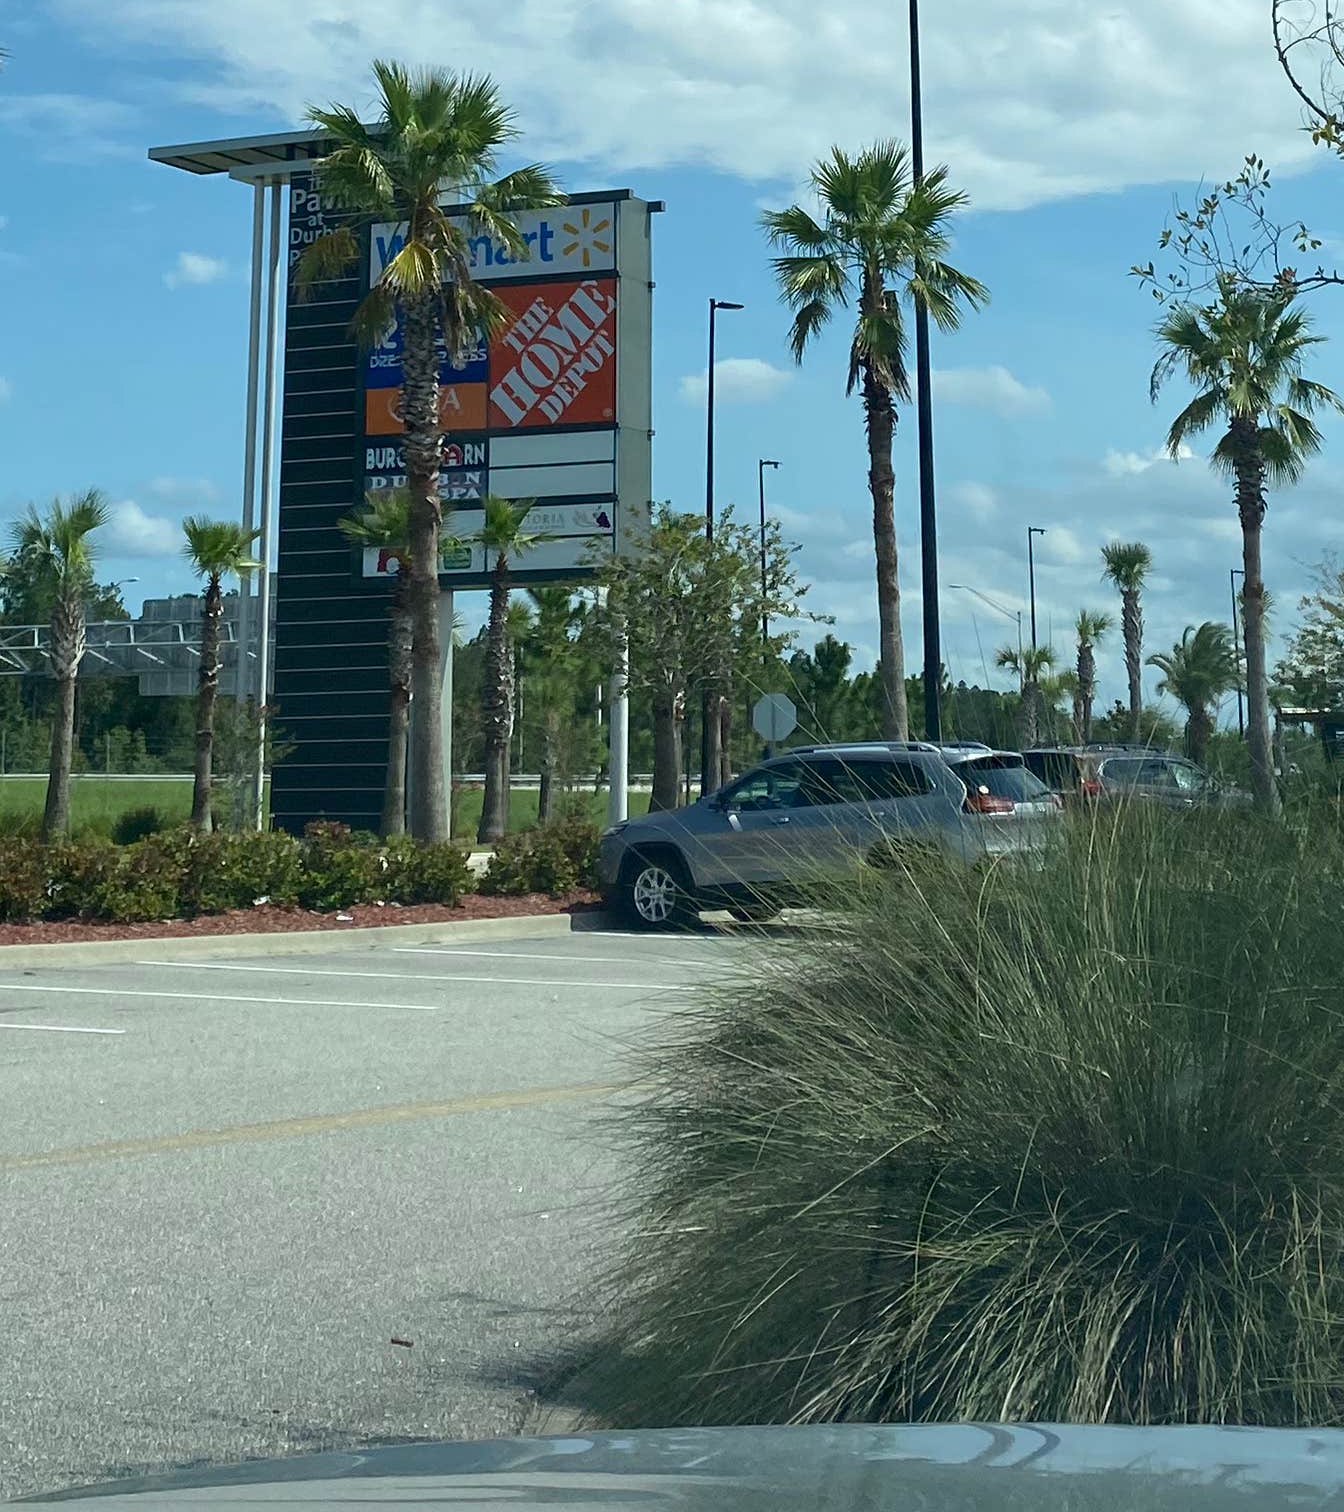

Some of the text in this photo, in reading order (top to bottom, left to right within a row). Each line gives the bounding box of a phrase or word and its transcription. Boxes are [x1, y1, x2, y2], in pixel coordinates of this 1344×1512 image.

[308, 212, 324, 227] at
[376, 221, 554, 269] Wmart
[489, 280, 616, 427] HOME
[503, 296, 555, 354] THE
[538, 329, 615, 424] DEPOT
